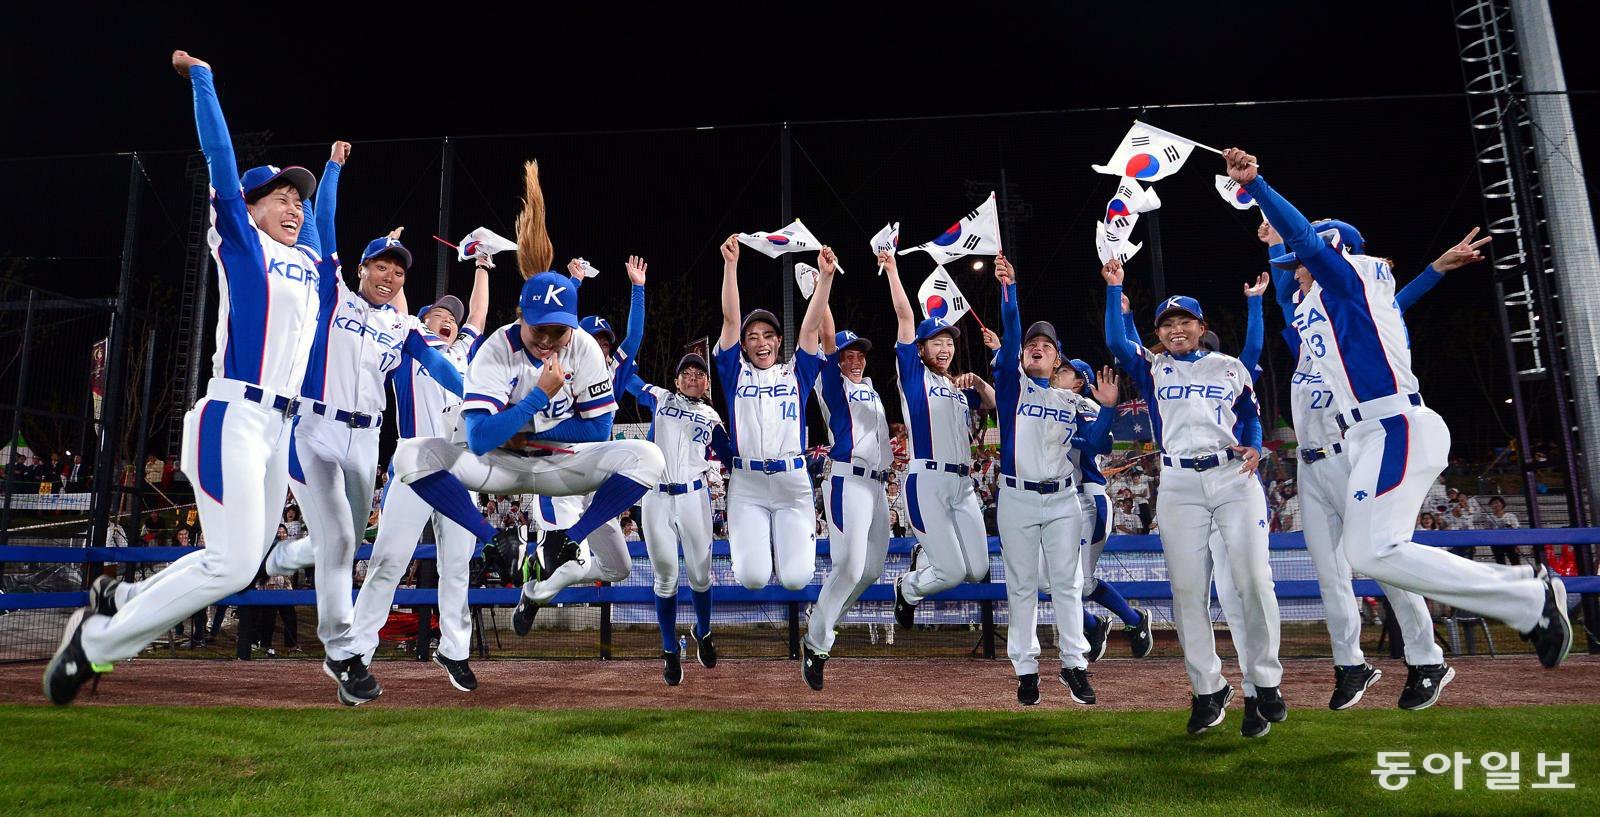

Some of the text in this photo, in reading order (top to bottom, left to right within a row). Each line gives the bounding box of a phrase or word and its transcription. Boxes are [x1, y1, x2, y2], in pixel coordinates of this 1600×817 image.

[386, 237, 400, 247] K
[268, 258, 320, 286] KOR
[544, 284, 566, 307] K
[1167, 297, 1182, 309] K
[594, 316, 606, 328] K
[934, 317, 948, 327] K
[332, 315, 404, 351] KOREA
[845, 331, 859, 340] K
[379, 352, 396, 372] 17
[590, 386, 601, 395] LG
[735, 384, 798, 399] KOREA
[1157, 384, 1234, 405] KOREA
[1311, 390, 1334, 409] 27
[657, 406, 713, 430] KOREA
[780, 401, 797, 421] 14
[1215, 404, 1222, 425] 1
[692, 427, 710, 446] 29
[1062, 427, 1073, 445] 7
